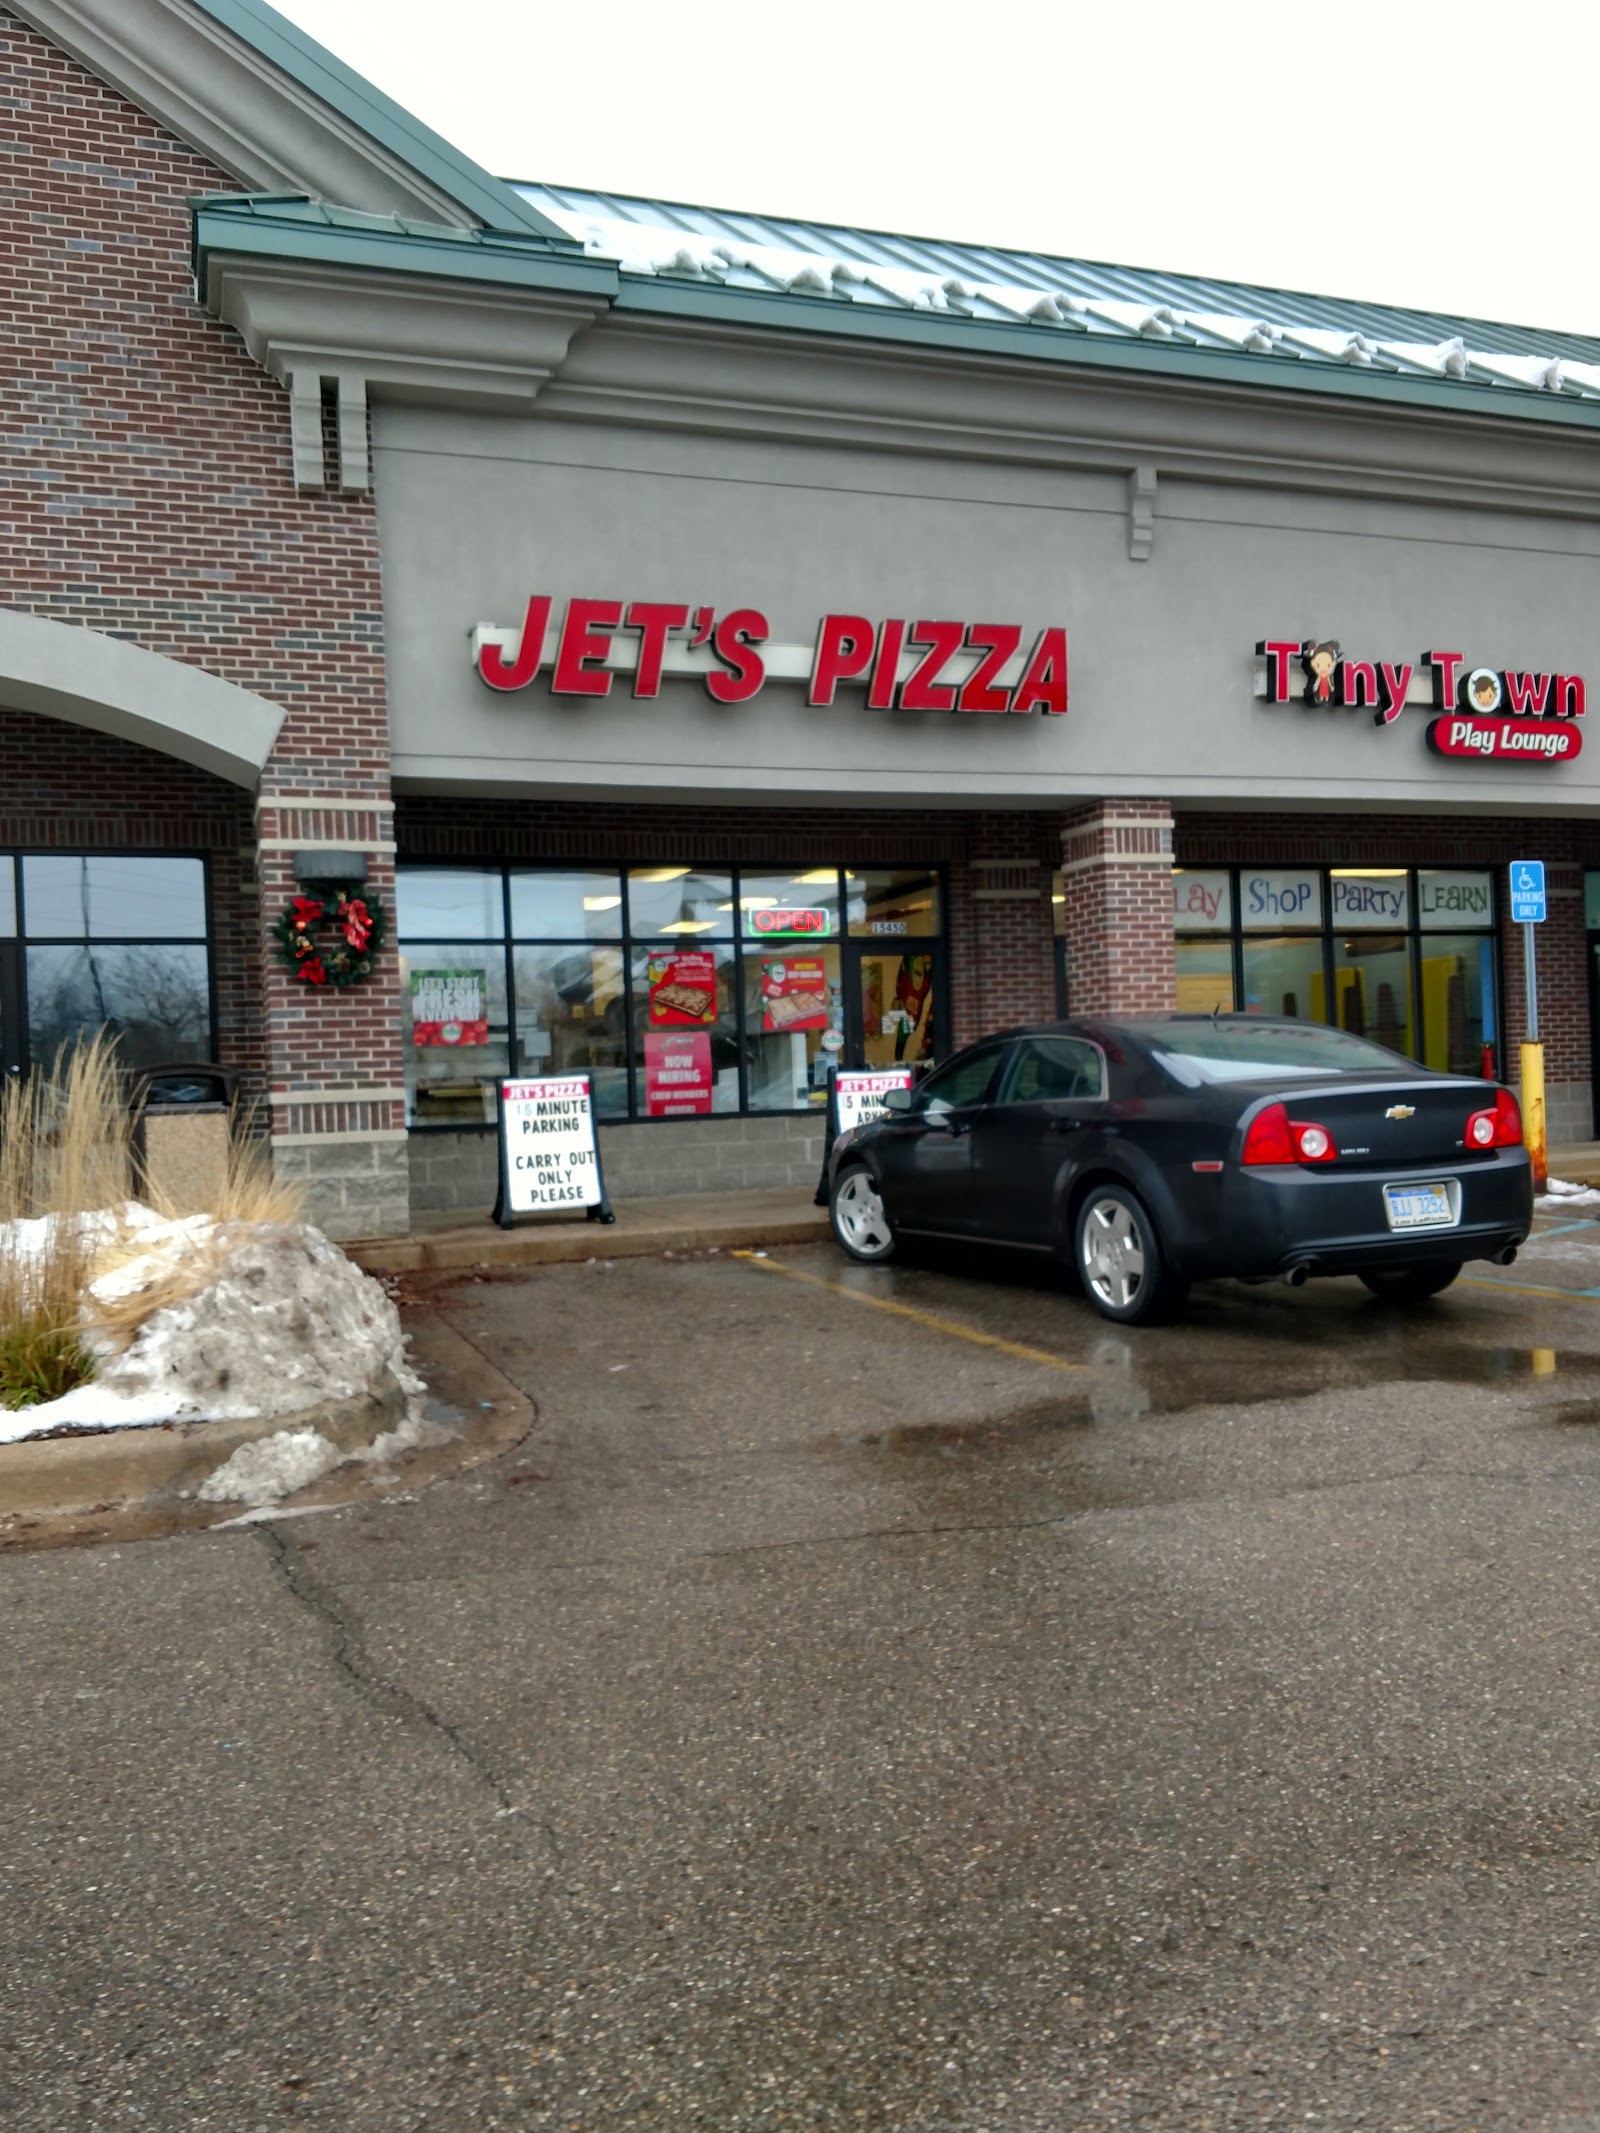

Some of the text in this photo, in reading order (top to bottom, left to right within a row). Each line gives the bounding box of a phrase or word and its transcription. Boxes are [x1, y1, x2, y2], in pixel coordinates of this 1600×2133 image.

[478, 595, 1068, 714] JET'S PIZZA
[1450, 722, 1570, 757] Play Lounge
[1512, 891, 1545, 903] PARKING
[1519, 905, 1538, 917] ONLY
[755, 911, 823, 932] OPEN
[873, 923, 906, 933] 15450
[446, 976, 479, 989] START
[419, 988, 480, 1009] FRESH
[665, 1055, 693, 1068] NOW
[658, 1069, 701, 1084] HIRING
[510, 1083, 584, 1099] JET'S PIZZA
[842, 1078, 905, 1092] JET'S PIZZA
[537, 1099, 588, 1116] MINUTE
[523, 1118, 580, 1134] PARKING
[516, 1151, 595, 1170] CARRY OUT
[538, 1170, 572, 1185] ONLY
[531, 1186, 584, 1203] PLEASE
